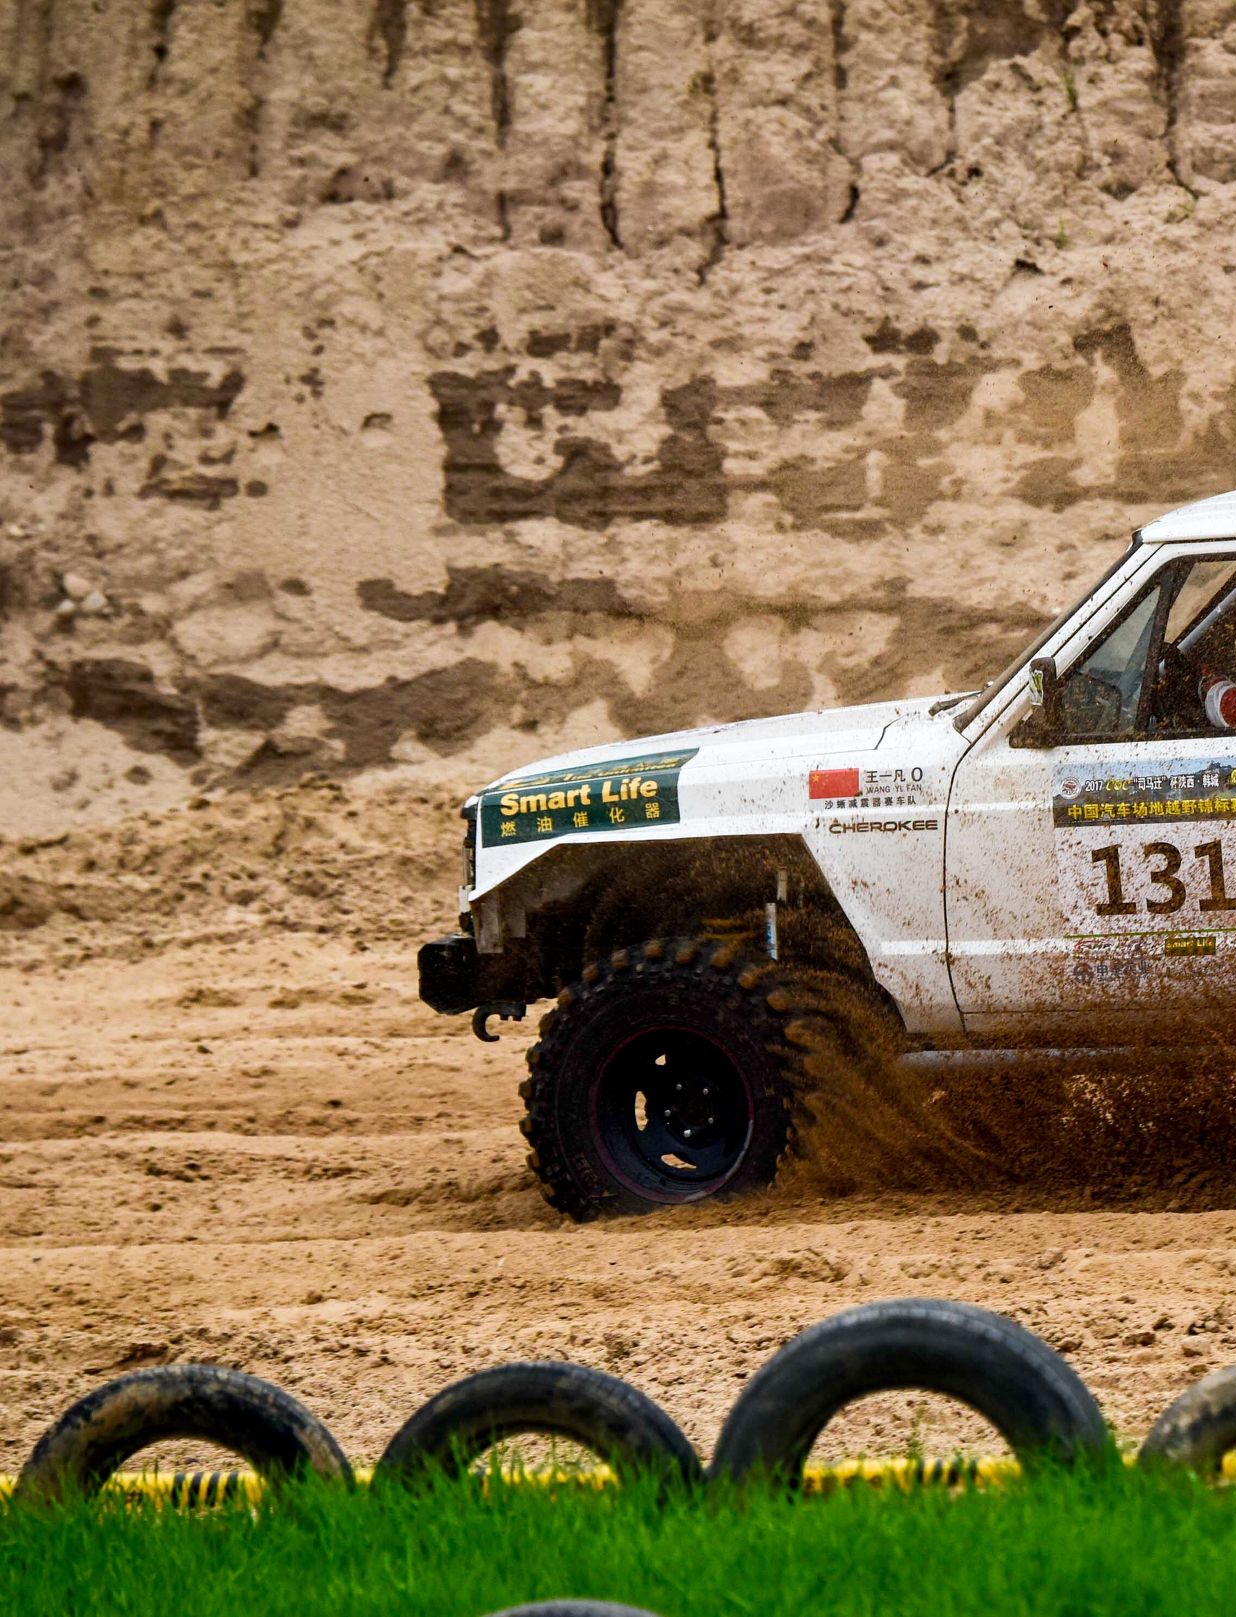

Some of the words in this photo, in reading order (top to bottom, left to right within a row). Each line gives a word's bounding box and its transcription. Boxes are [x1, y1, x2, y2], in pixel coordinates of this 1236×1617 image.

[865, 770, 905, 783] 王一凡
[866, 786, 891, 794] WANG
[907, 784, 922, 792] FAN
[1085, 780, 1103, 792] 2017
[501, 784, 590, 816] Smart
[602, 777, 658, 803] Life
[501, 802, 660, 837] 燃油催化器
[829, 820, 938, 834] CHEROKEE
